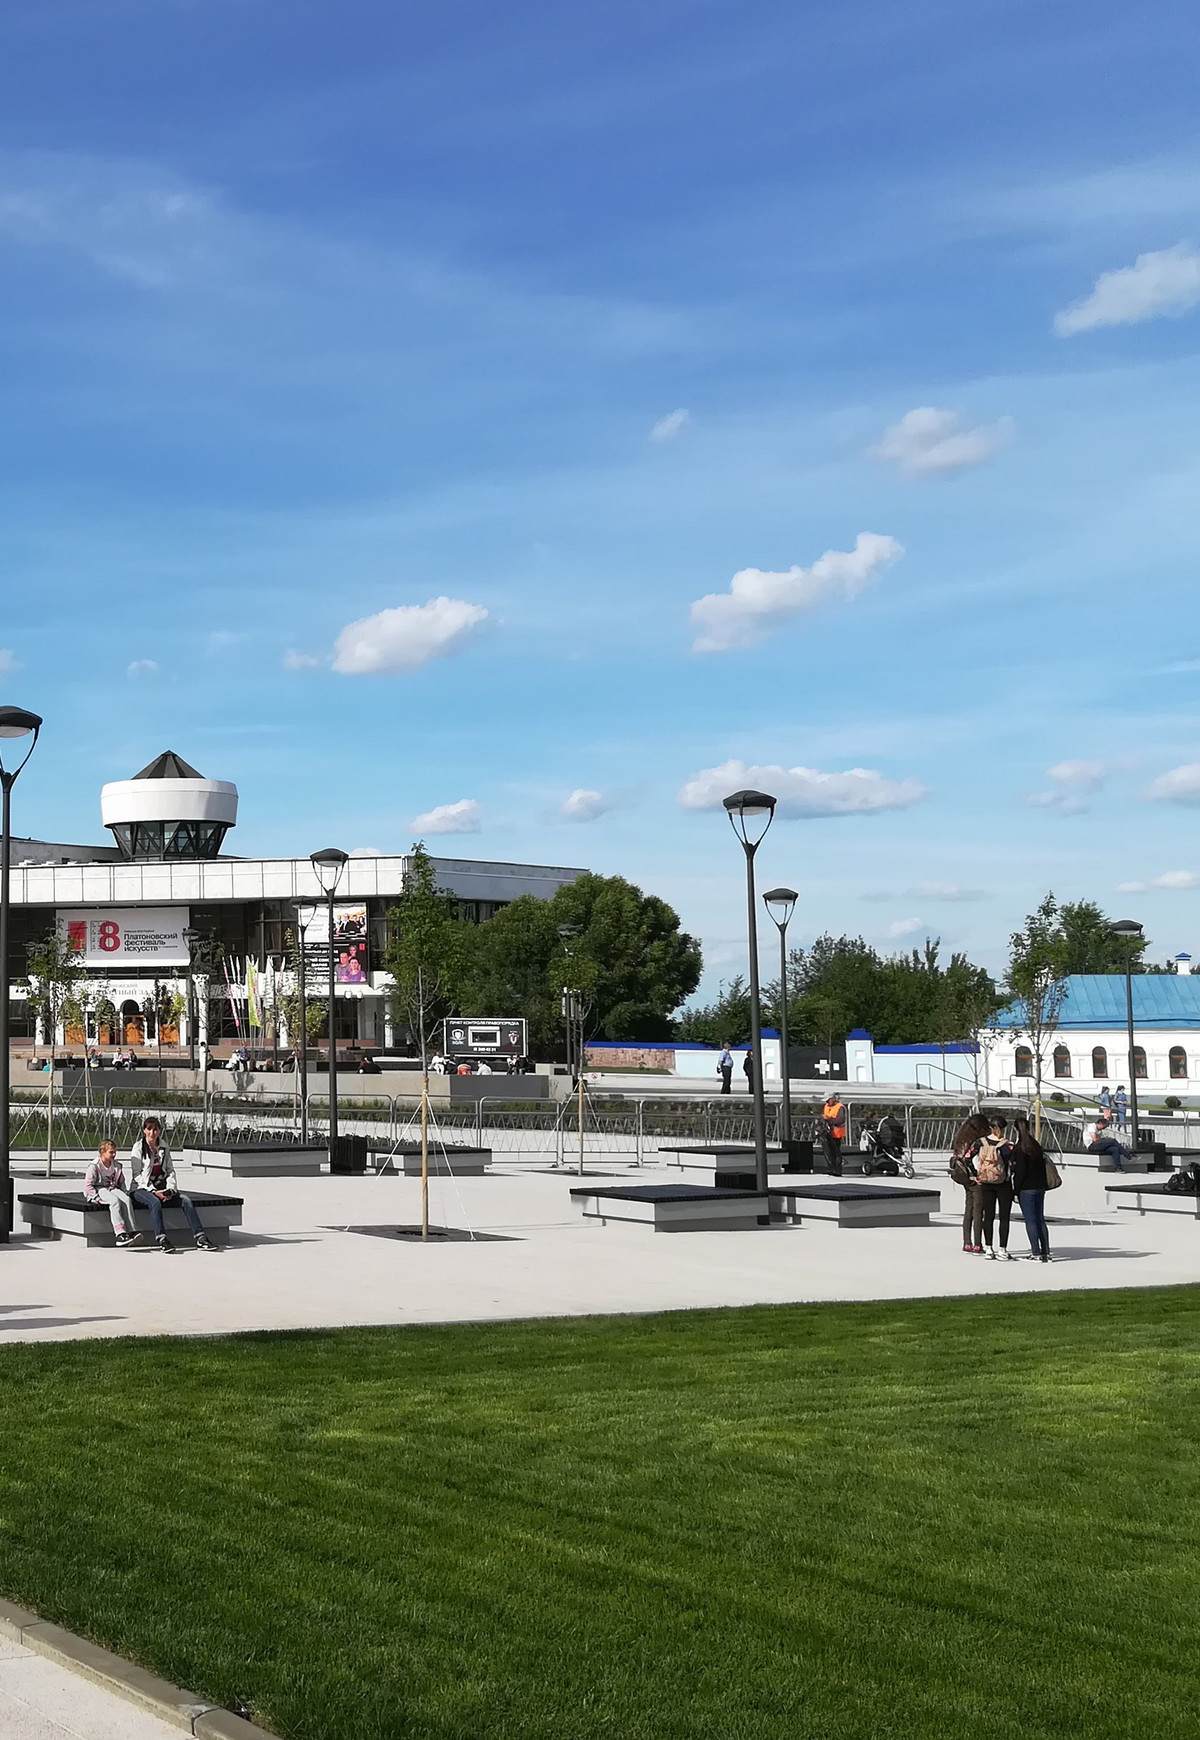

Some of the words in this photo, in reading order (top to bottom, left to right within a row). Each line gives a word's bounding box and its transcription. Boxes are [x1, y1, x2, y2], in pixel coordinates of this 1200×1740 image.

[99, 921, 120, 952] 8
[124, 932, 178, 940] Платоновский
[124, 945, 159, 953] искусств
